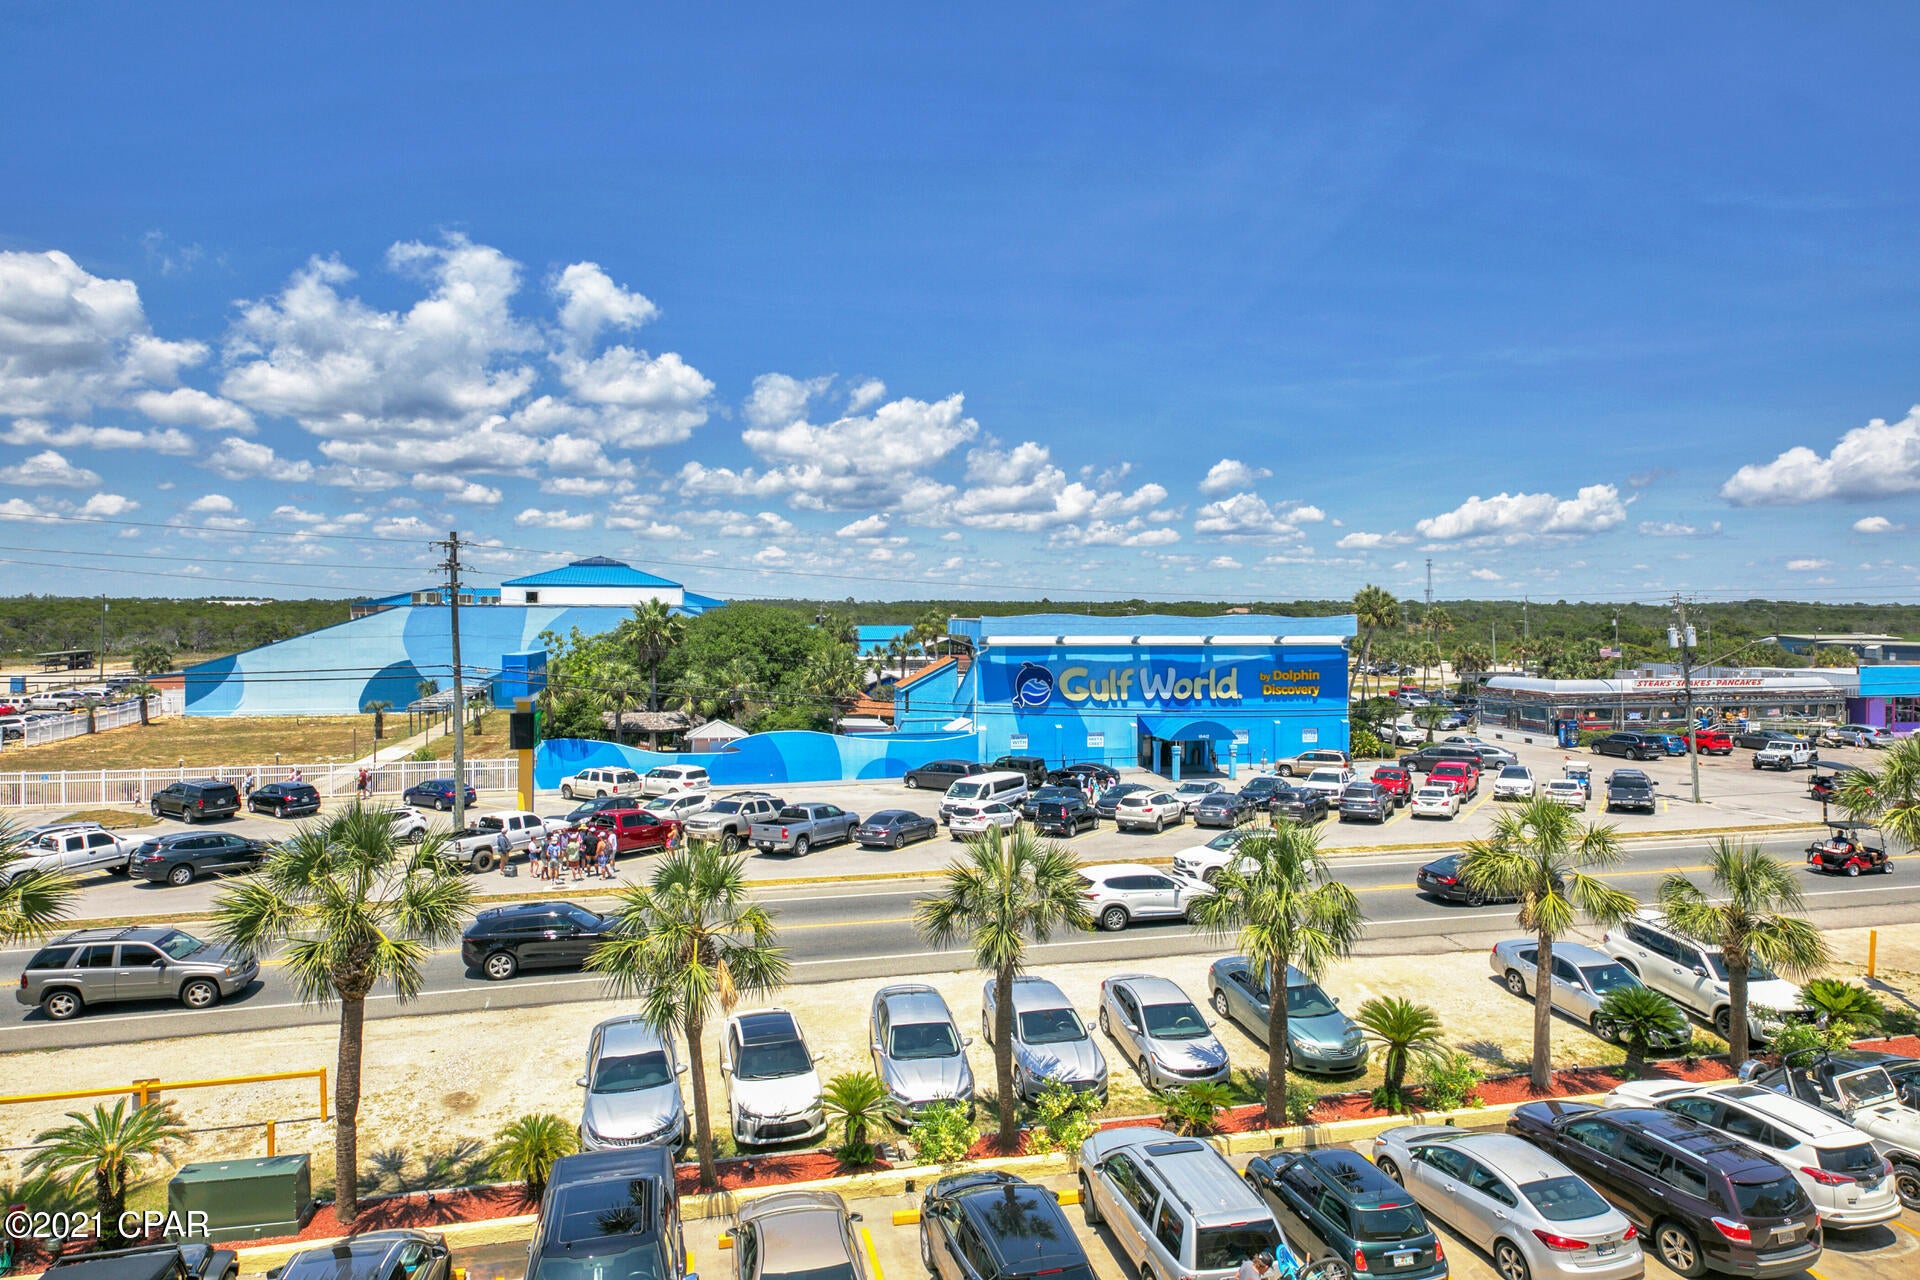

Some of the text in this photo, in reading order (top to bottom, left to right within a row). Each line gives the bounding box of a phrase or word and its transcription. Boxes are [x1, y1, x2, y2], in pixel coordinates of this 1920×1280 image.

[1260, 669, 1320, 682] by Dolphin
[1058, 667, 1135, 702] Gulf
[1262, 684, 1320, 697] Discovery
